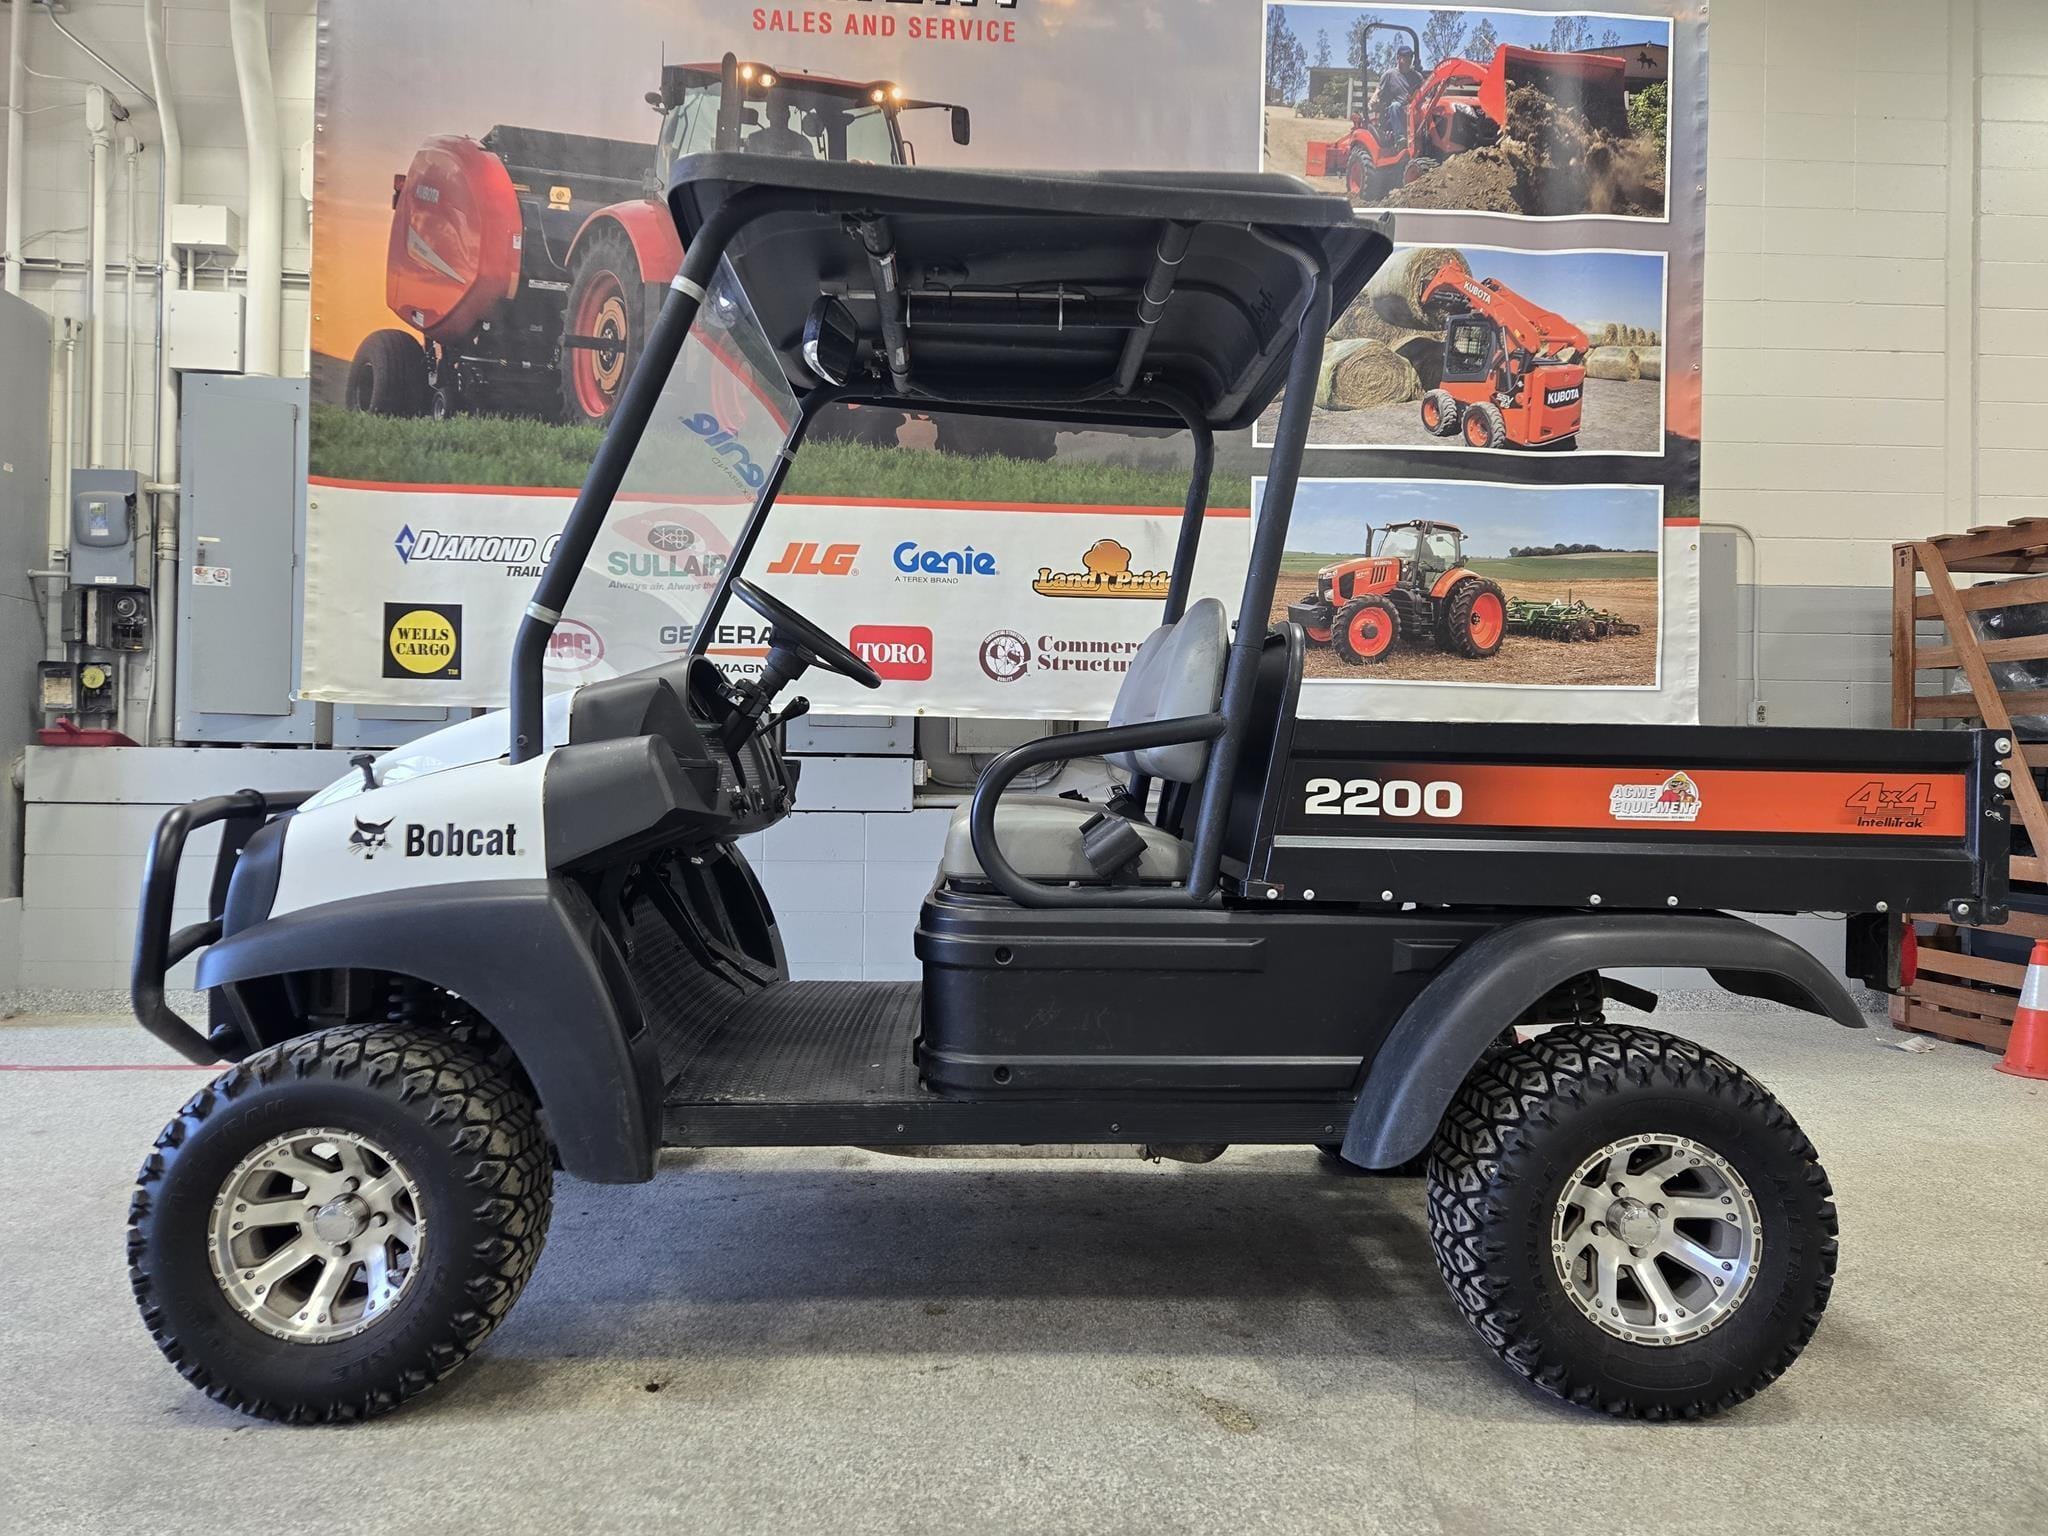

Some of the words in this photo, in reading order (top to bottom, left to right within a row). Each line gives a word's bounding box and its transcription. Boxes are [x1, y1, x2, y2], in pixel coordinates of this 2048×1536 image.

[752, 8, 832, 34] SALES
[844, 13, 896, 37] AND
[908, 16, 1016, 43] SERVICE
[1463, 280, 1491, 304] KUBOTA
[1547, 388, 1580, 405] KUBOTA
[410, 530, 537, 563] DIAMOND
[607, 551, 727, 577] SULLAIR
[766, 542, 861, 576] JLG
[893, 541, 997, 576] Genie
[506, 565, 545, 578] TRAIL
[1037, 567, 1099, 591] Land
[1113, 569, 1171, 591] Prid
[608, 580, 647, 592] Always
[667, 580, 702, 591] Always
[397, 627, 449, 641] WELLS
[659, 625, 772, 645] GEERA
[395, 642, 450, 656] CARGO
[856, 643, 926, 664] TORO
[1038, 635, 1144, 654] Commer
[714, 663, 767, 673] MAGN
[1038, 655, 1132, 673] Structu
[1305, 778, 1463, 818] 2200
[1612, 786, 1658, 800] ACME
[1845, 782, 1937, 816] 4x4
[1612, 800, 1700, 815] EQUIPMENT
[1857, 816, 1923, 828] IntelliTrak
[405, 823, 517, 858] Bobcat
